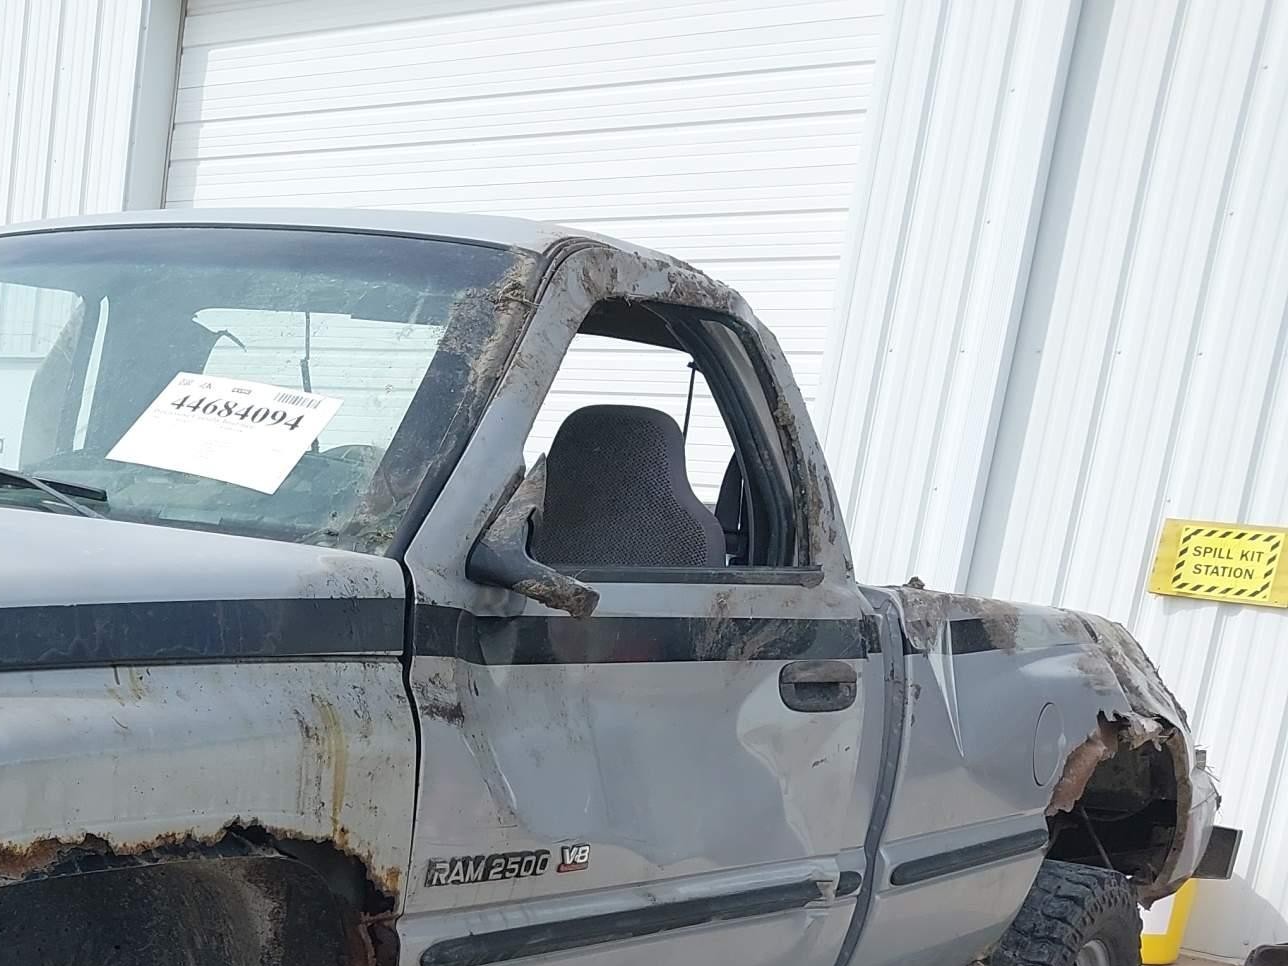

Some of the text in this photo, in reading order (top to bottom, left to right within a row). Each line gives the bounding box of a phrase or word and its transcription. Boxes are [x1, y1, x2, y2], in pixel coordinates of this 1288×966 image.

[171, 394, 305, 431] 44684094
[1192, 545, 1264, 562] SPILL KIT
[1192, 563, 1255, 579] STATION
[425, 844, 591, 887] RAM 2500 V8
